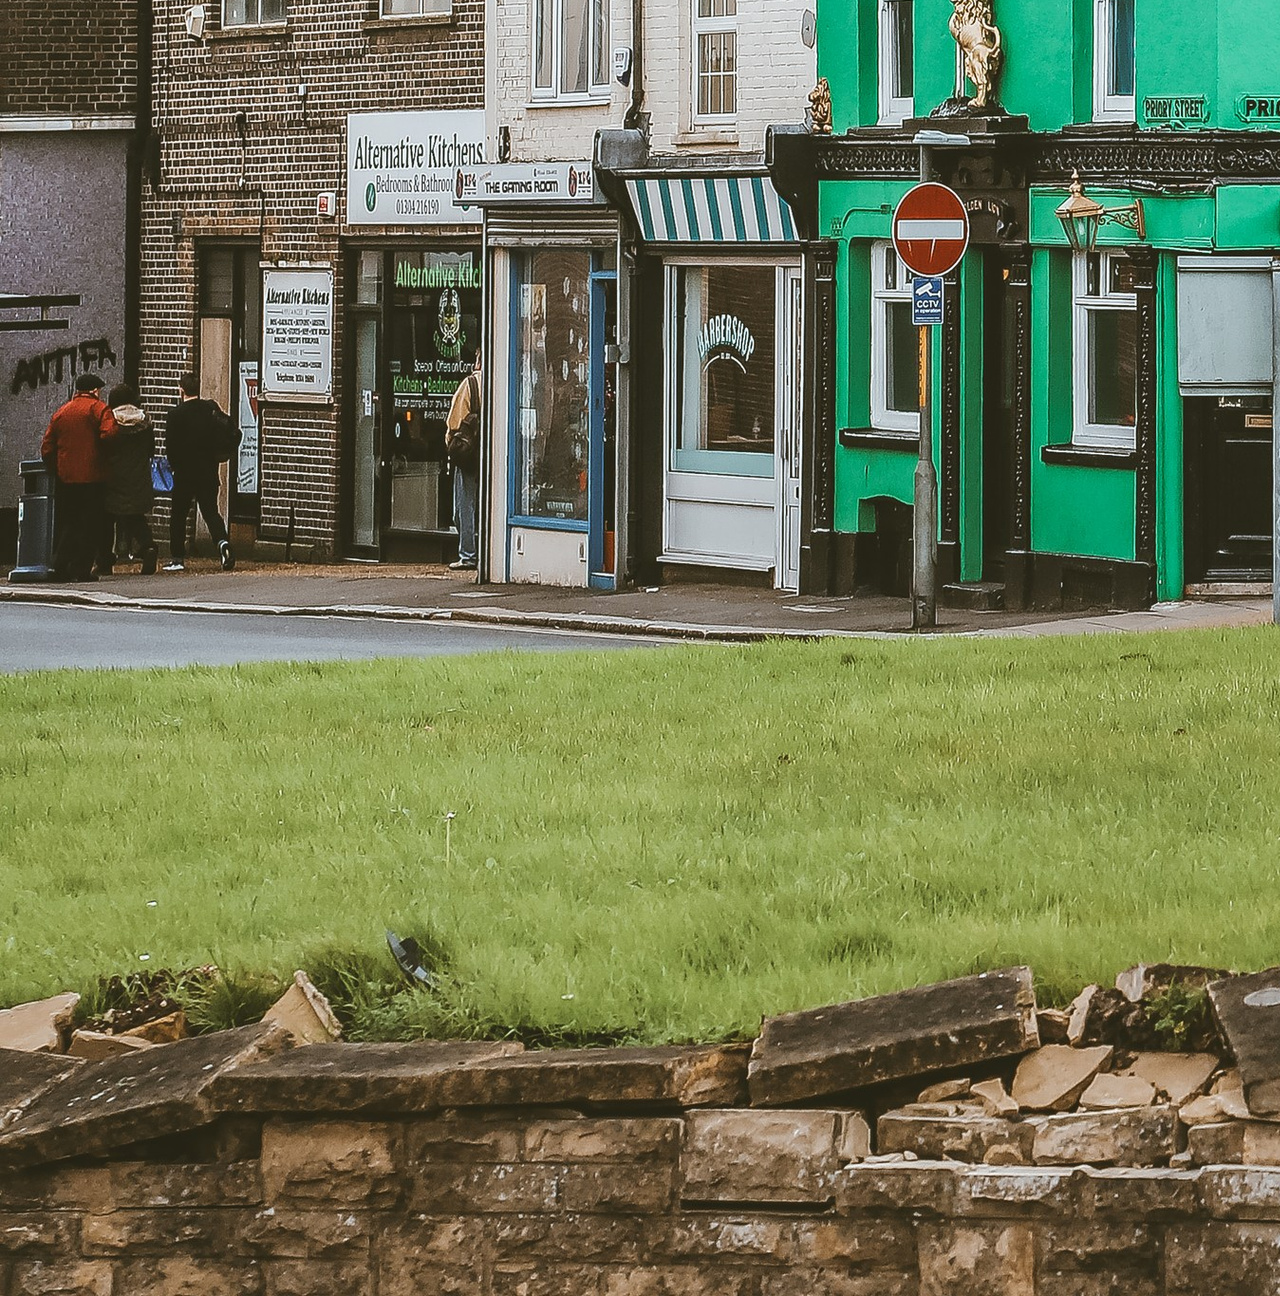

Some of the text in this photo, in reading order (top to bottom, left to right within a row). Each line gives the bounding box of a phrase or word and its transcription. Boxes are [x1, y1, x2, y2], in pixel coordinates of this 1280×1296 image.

[1145, 99, 1205, 118] PRIORY STREET
[354, 134, 483, 170] Alternative Kitchens
[376, 174, 413, 193] Bedrooms
[413, 177, 420, 192] &
[485, 180, 559, 194] THE GAMING ROOM
[395, 261, 454, 288] Alternative
[266, 287, 330, 306] Alternative Kitchens
[916, 299, 939, 308] CCTV
[695, 314, 755, 362] BARBERSHOP
[10, 337, 117, 396] ANTIFA
[393, 375, 423, 393] Kitchens
